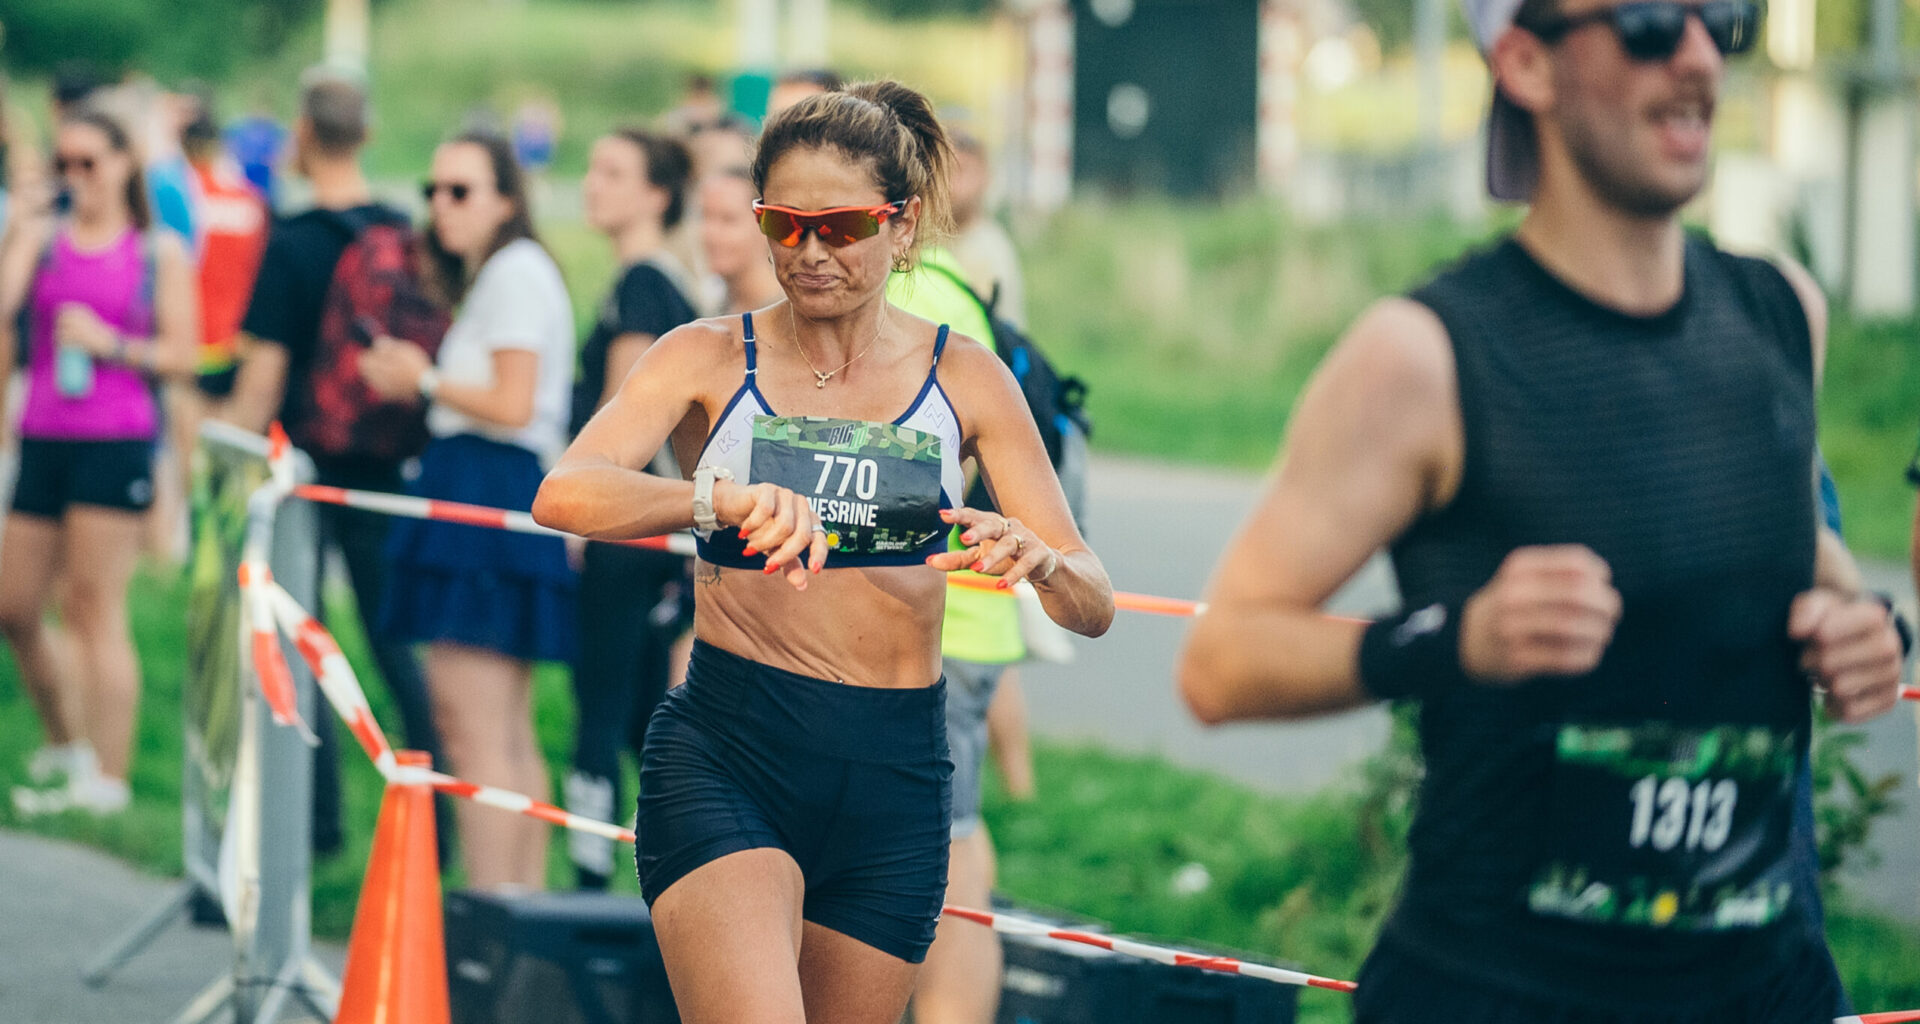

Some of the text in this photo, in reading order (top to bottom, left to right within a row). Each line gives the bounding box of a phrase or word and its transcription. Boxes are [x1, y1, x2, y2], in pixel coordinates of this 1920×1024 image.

[814, 453, 879, 501] 770
[805, 496, 879, 528] NESRINE
[1629, 773, 1738, 851] 1313
